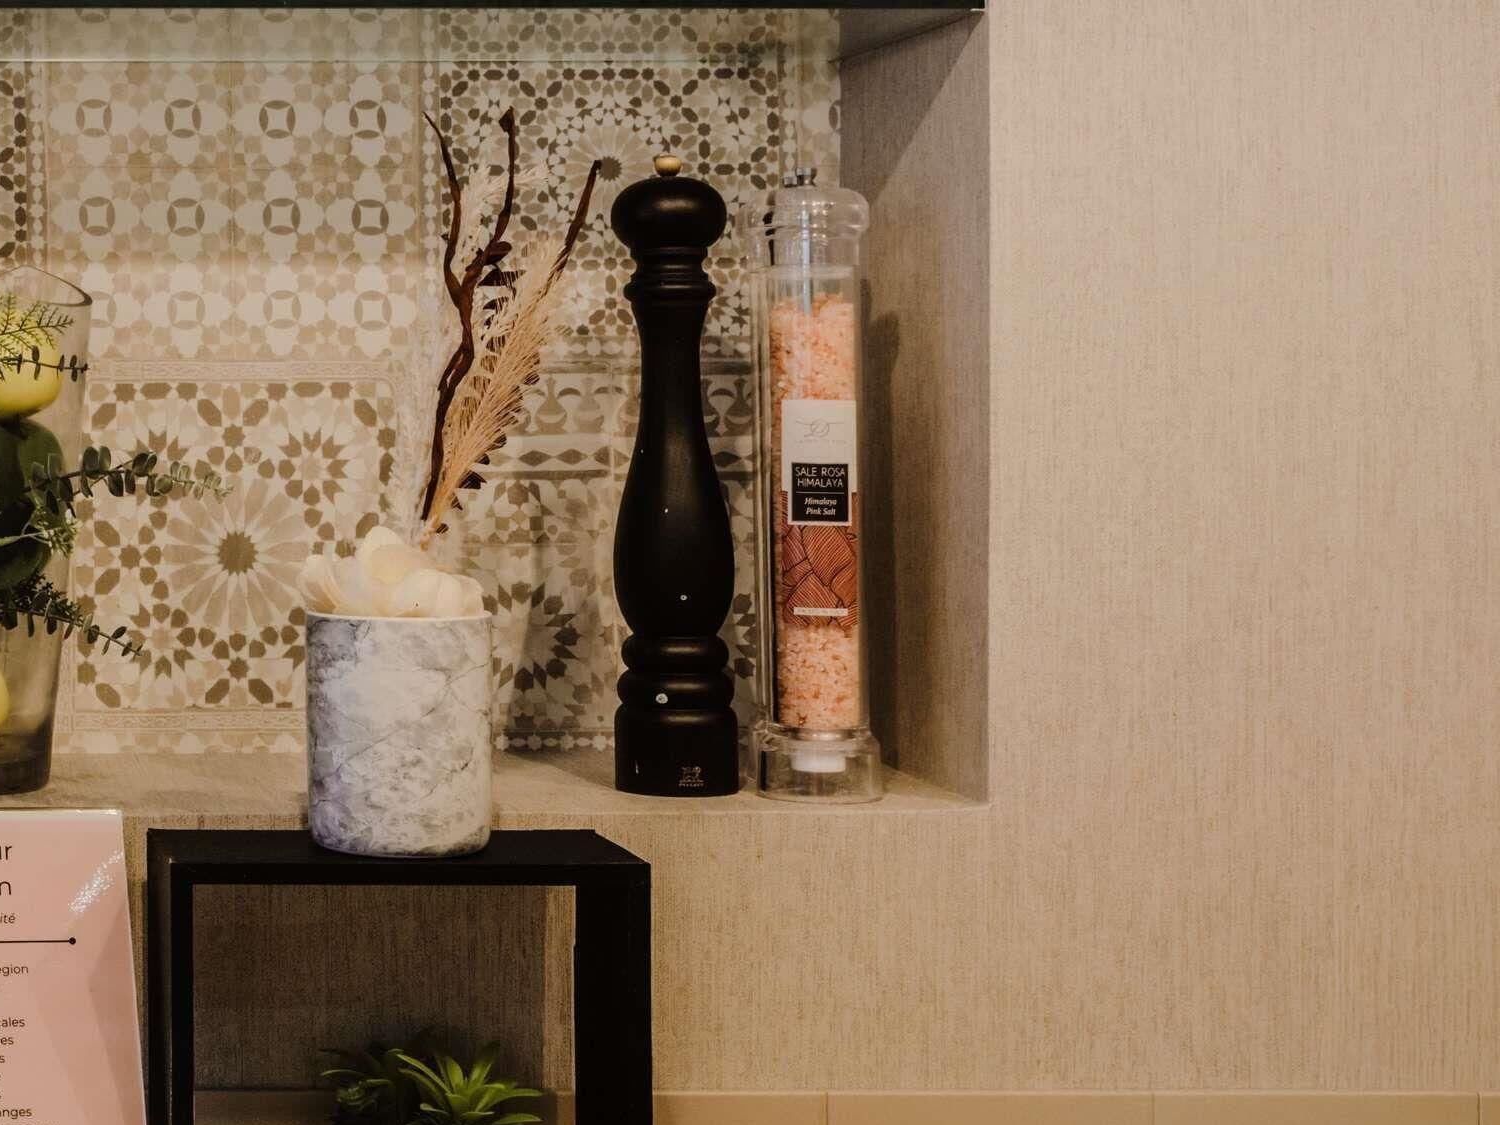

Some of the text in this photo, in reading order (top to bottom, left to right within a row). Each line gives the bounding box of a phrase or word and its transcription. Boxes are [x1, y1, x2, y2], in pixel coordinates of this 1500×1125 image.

[795, 466, 845, 477] SALE ROSA
[797, 478, 844, 488] HIMALAYA
[804, 497, 837, 506] Himalaya
[805, 507, 836, 516] Pink Salt
